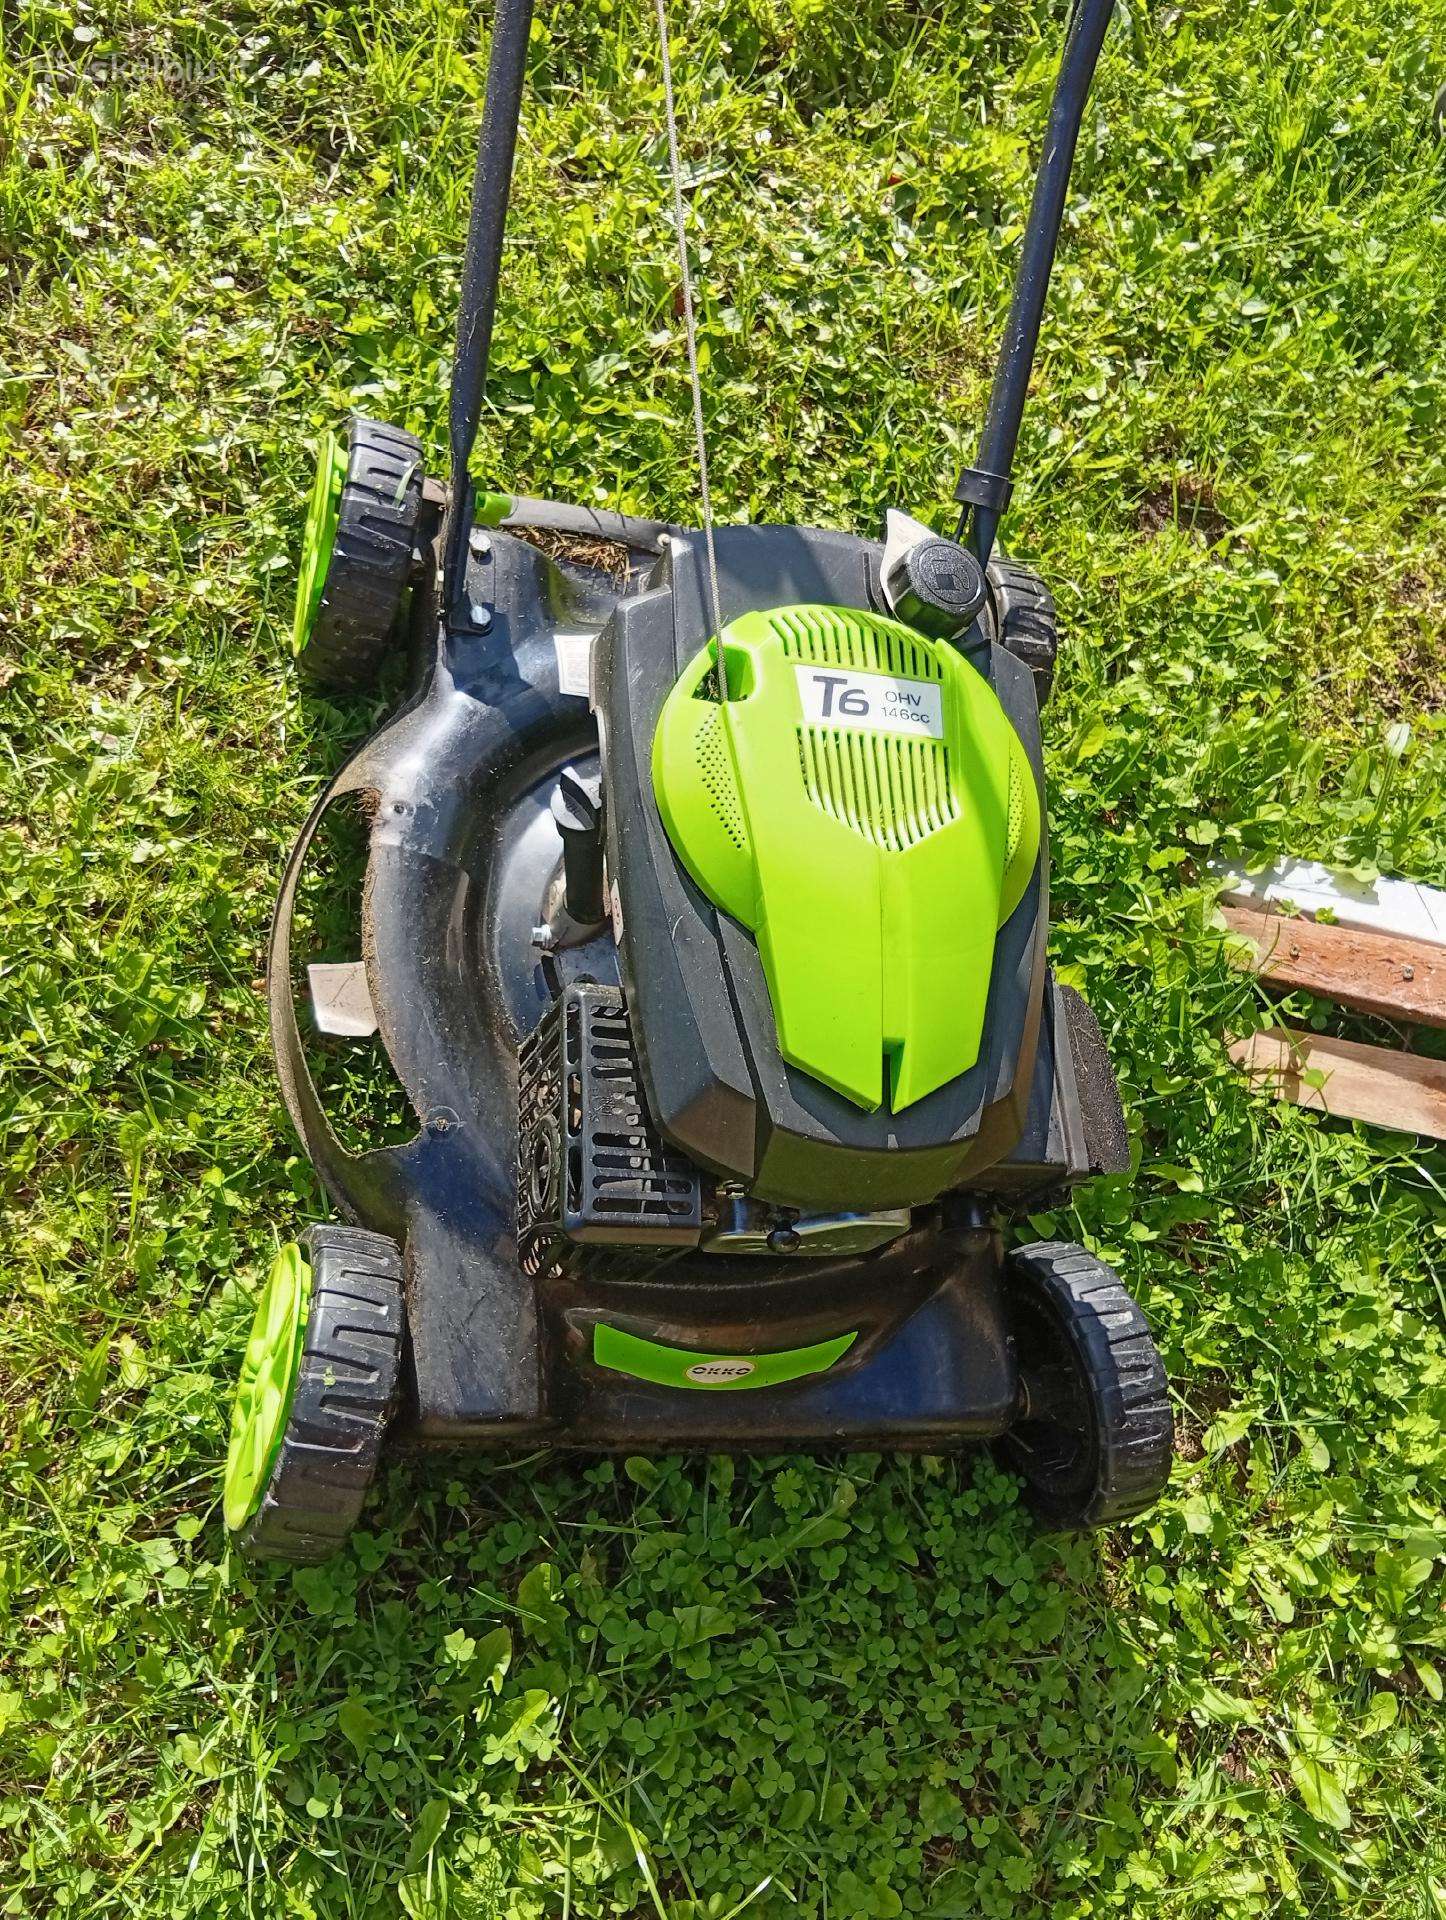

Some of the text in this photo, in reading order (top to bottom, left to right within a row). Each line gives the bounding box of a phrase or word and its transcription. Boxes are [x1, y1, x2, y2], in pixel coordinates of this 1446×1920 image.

[812, 675, 870, 718] T6
[885, 690, 922, 706] OHV
[881, 706, 931, 724] 146cc
[691, 1366, 751, 1375] OKKO
